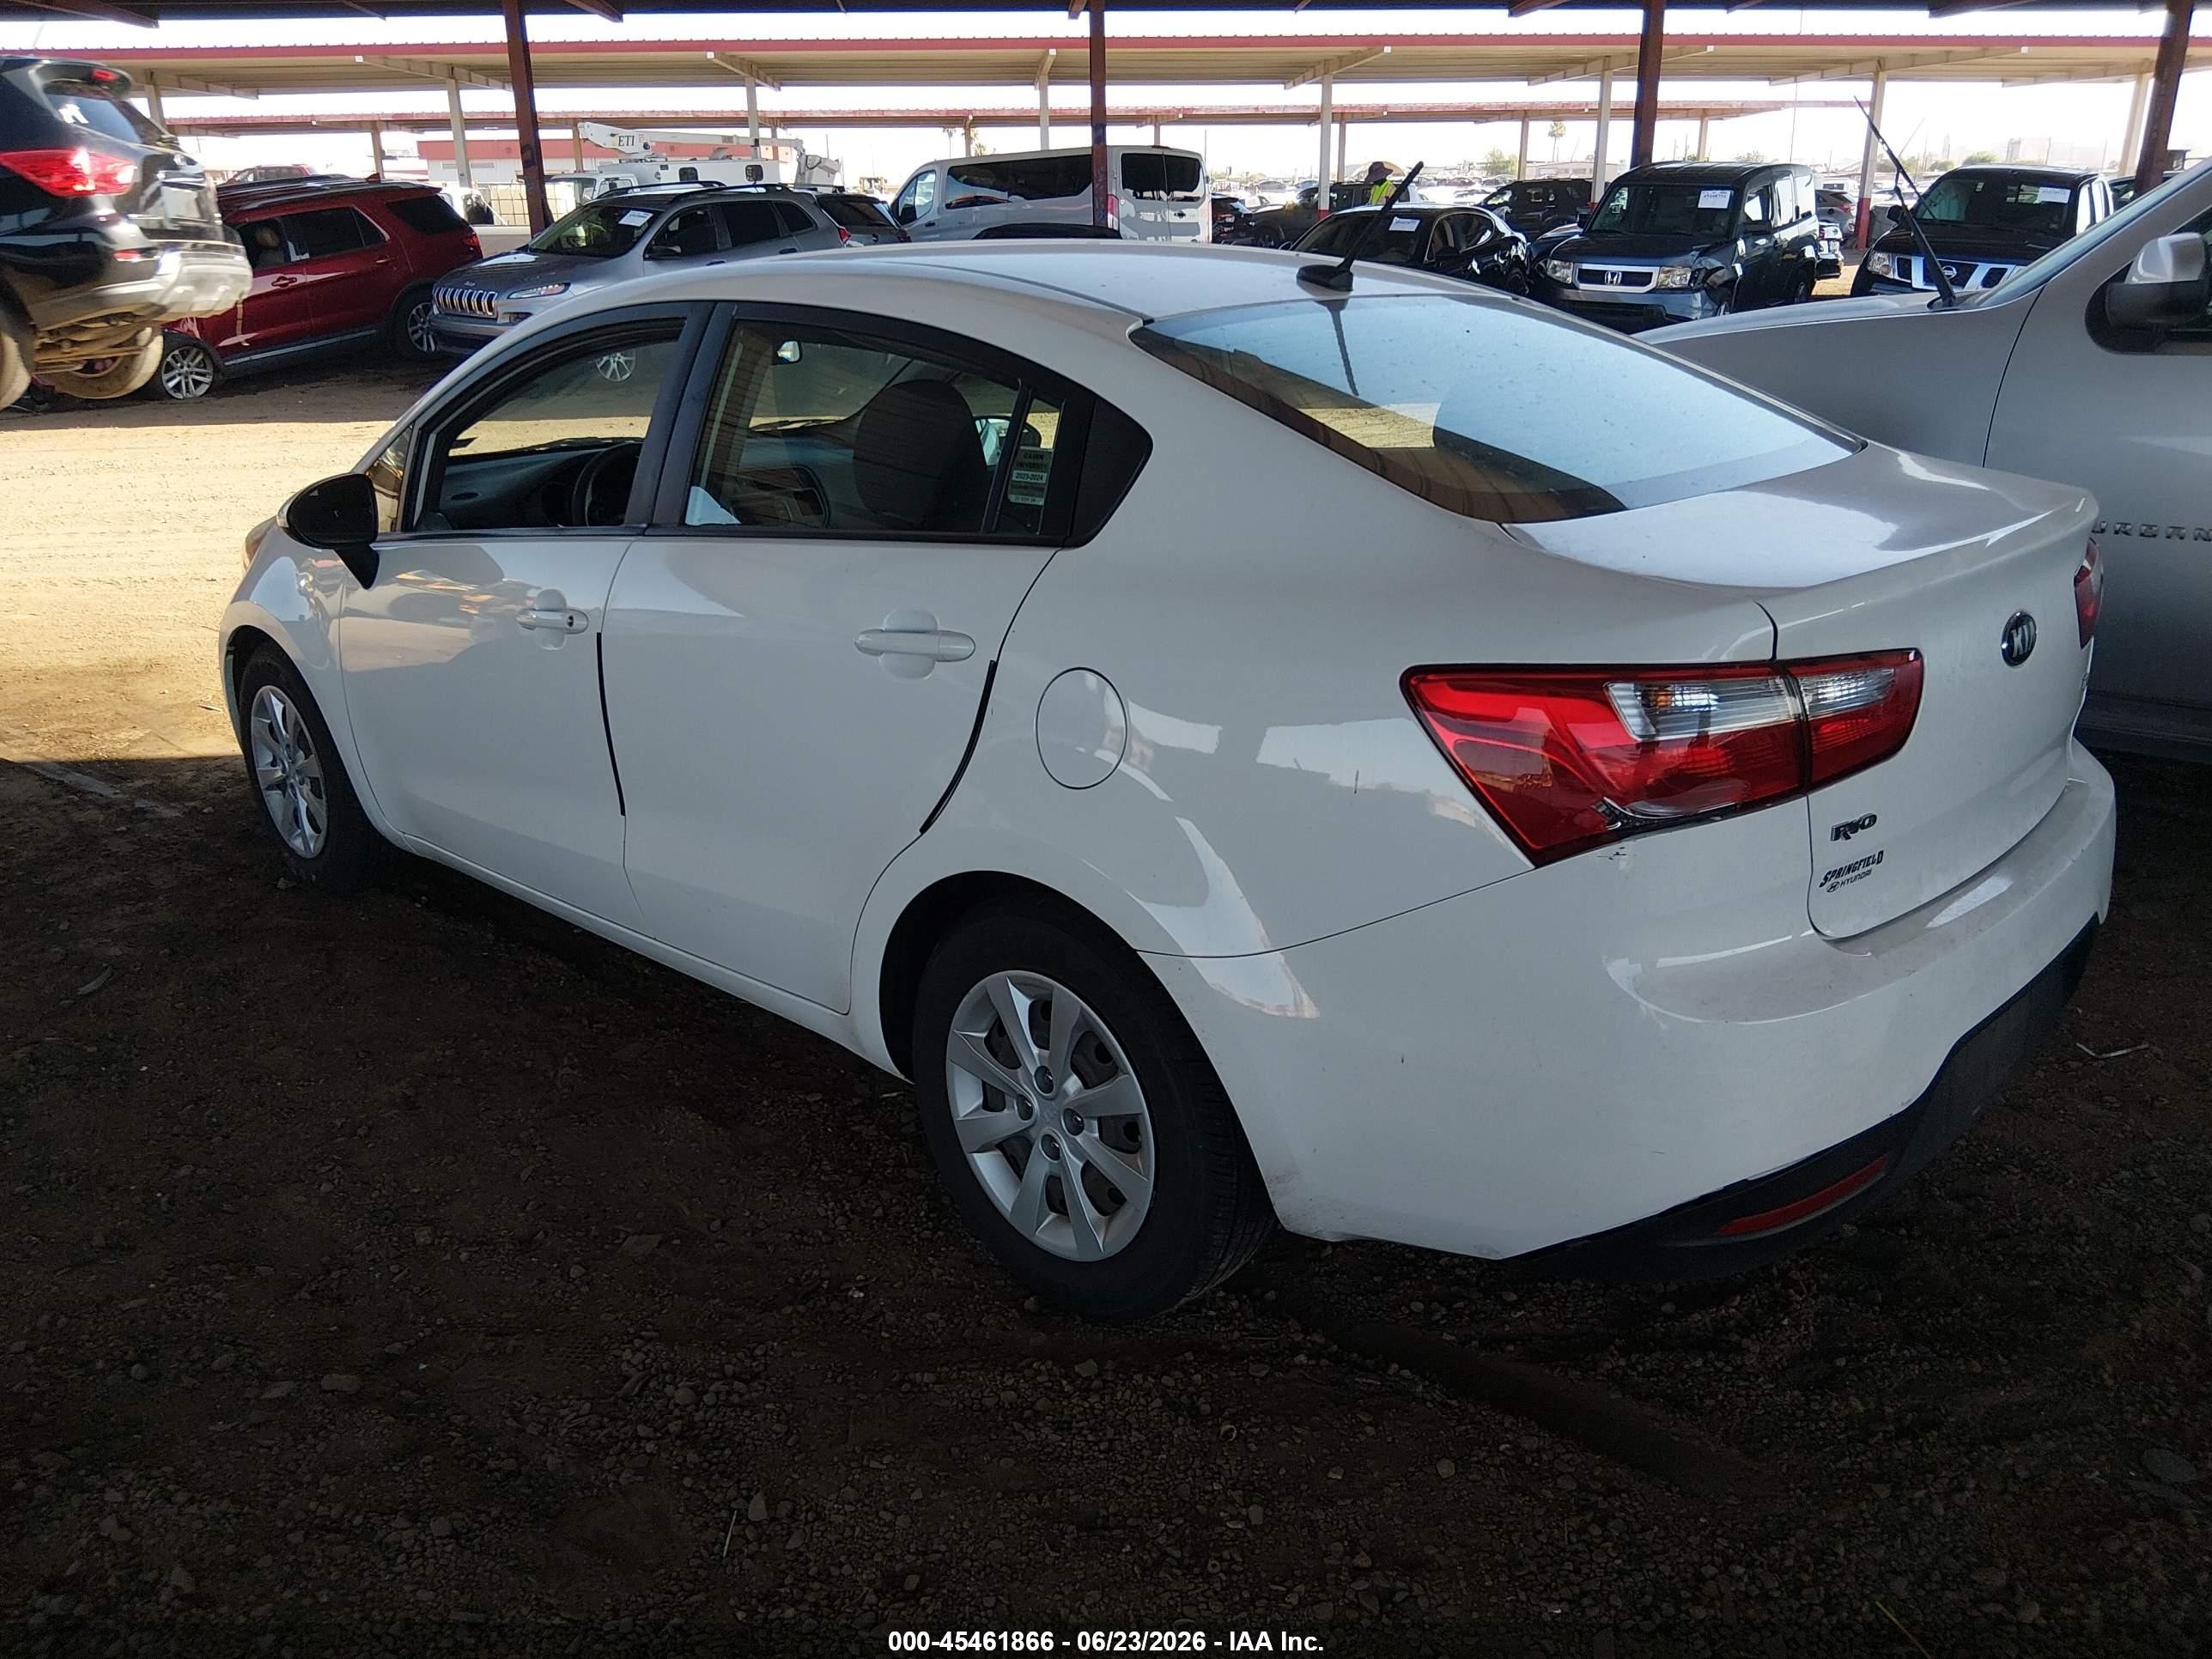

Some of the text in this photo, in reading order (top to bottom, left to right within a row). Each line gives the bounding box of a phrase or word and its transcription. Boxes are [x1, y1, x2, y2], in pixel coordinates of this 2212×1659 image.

[618, 135, 635, 147] ETI
[1819, 849, 1884, 888] SPRINGFIELD
[1839, 869, 1872, 888] HYUNDAI
